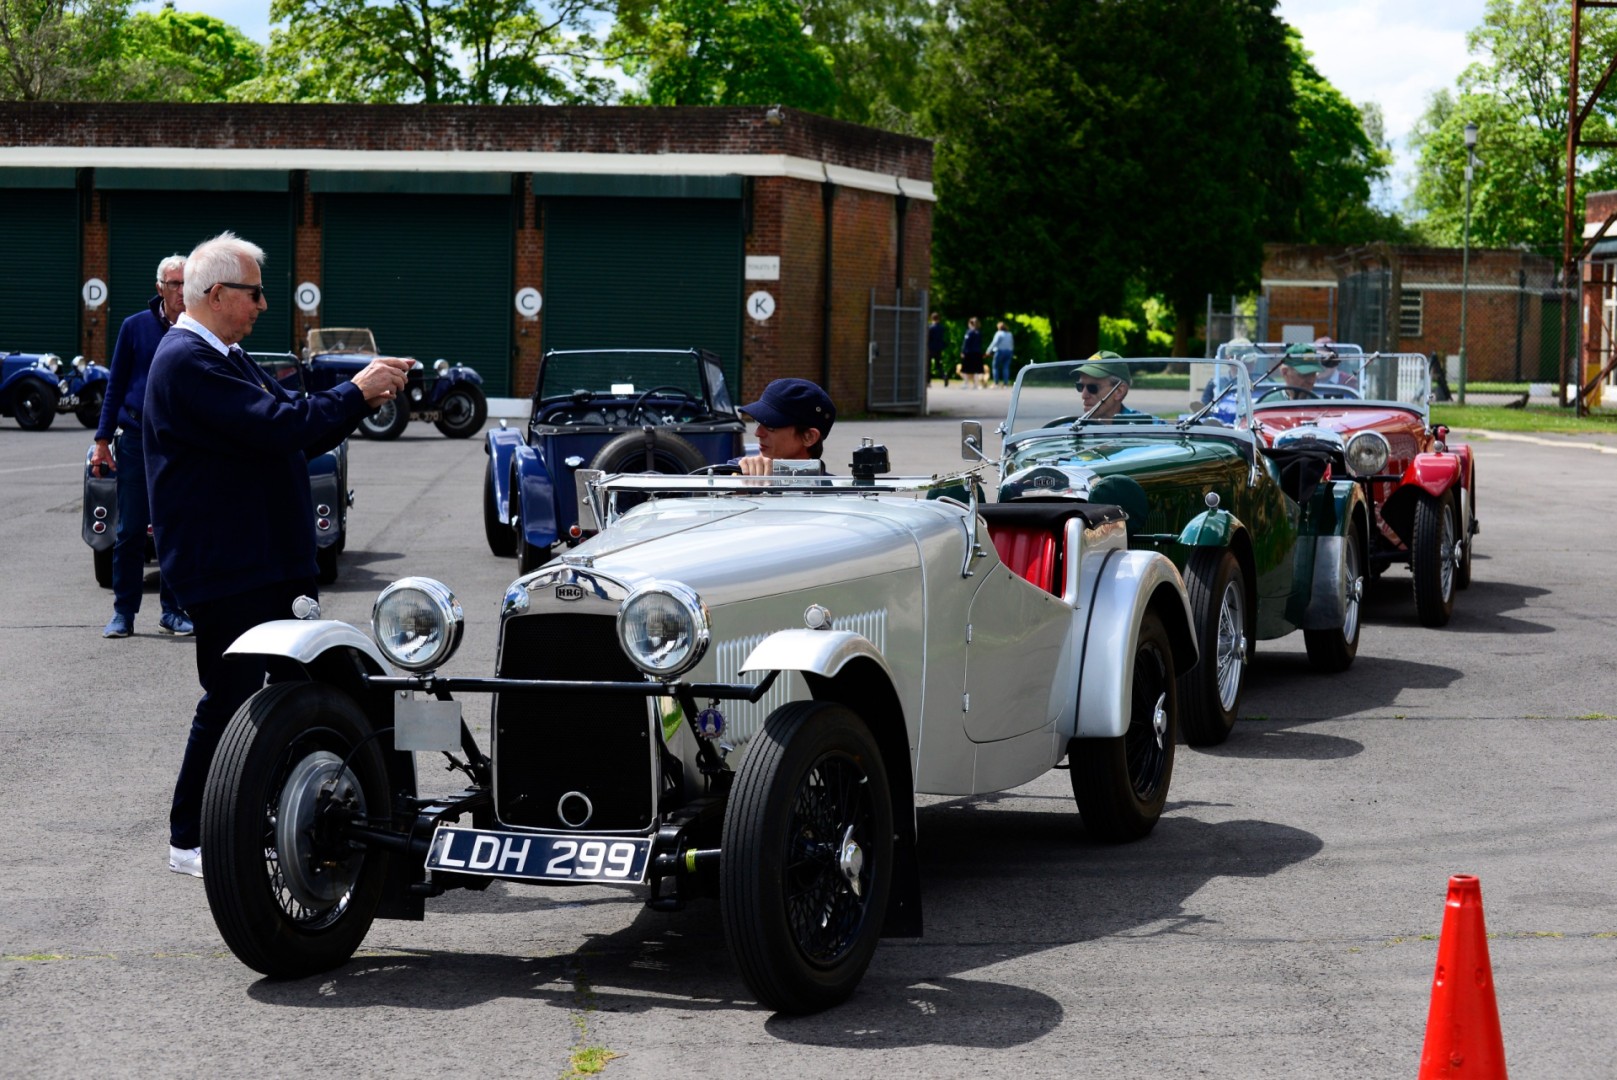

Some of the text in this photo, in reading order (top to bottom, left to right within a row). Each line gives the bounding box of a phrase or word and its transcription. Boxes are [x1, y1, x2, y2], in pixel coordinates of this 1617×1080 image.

[89, 285, 102, 300] D
[300, 289, 315, 305] O
[521, 294, 535, 310] C
[755, 298, 768, 314] K
[558, 588, 580, 597] HRG
[439, 832, 636, 878] LDH 299
